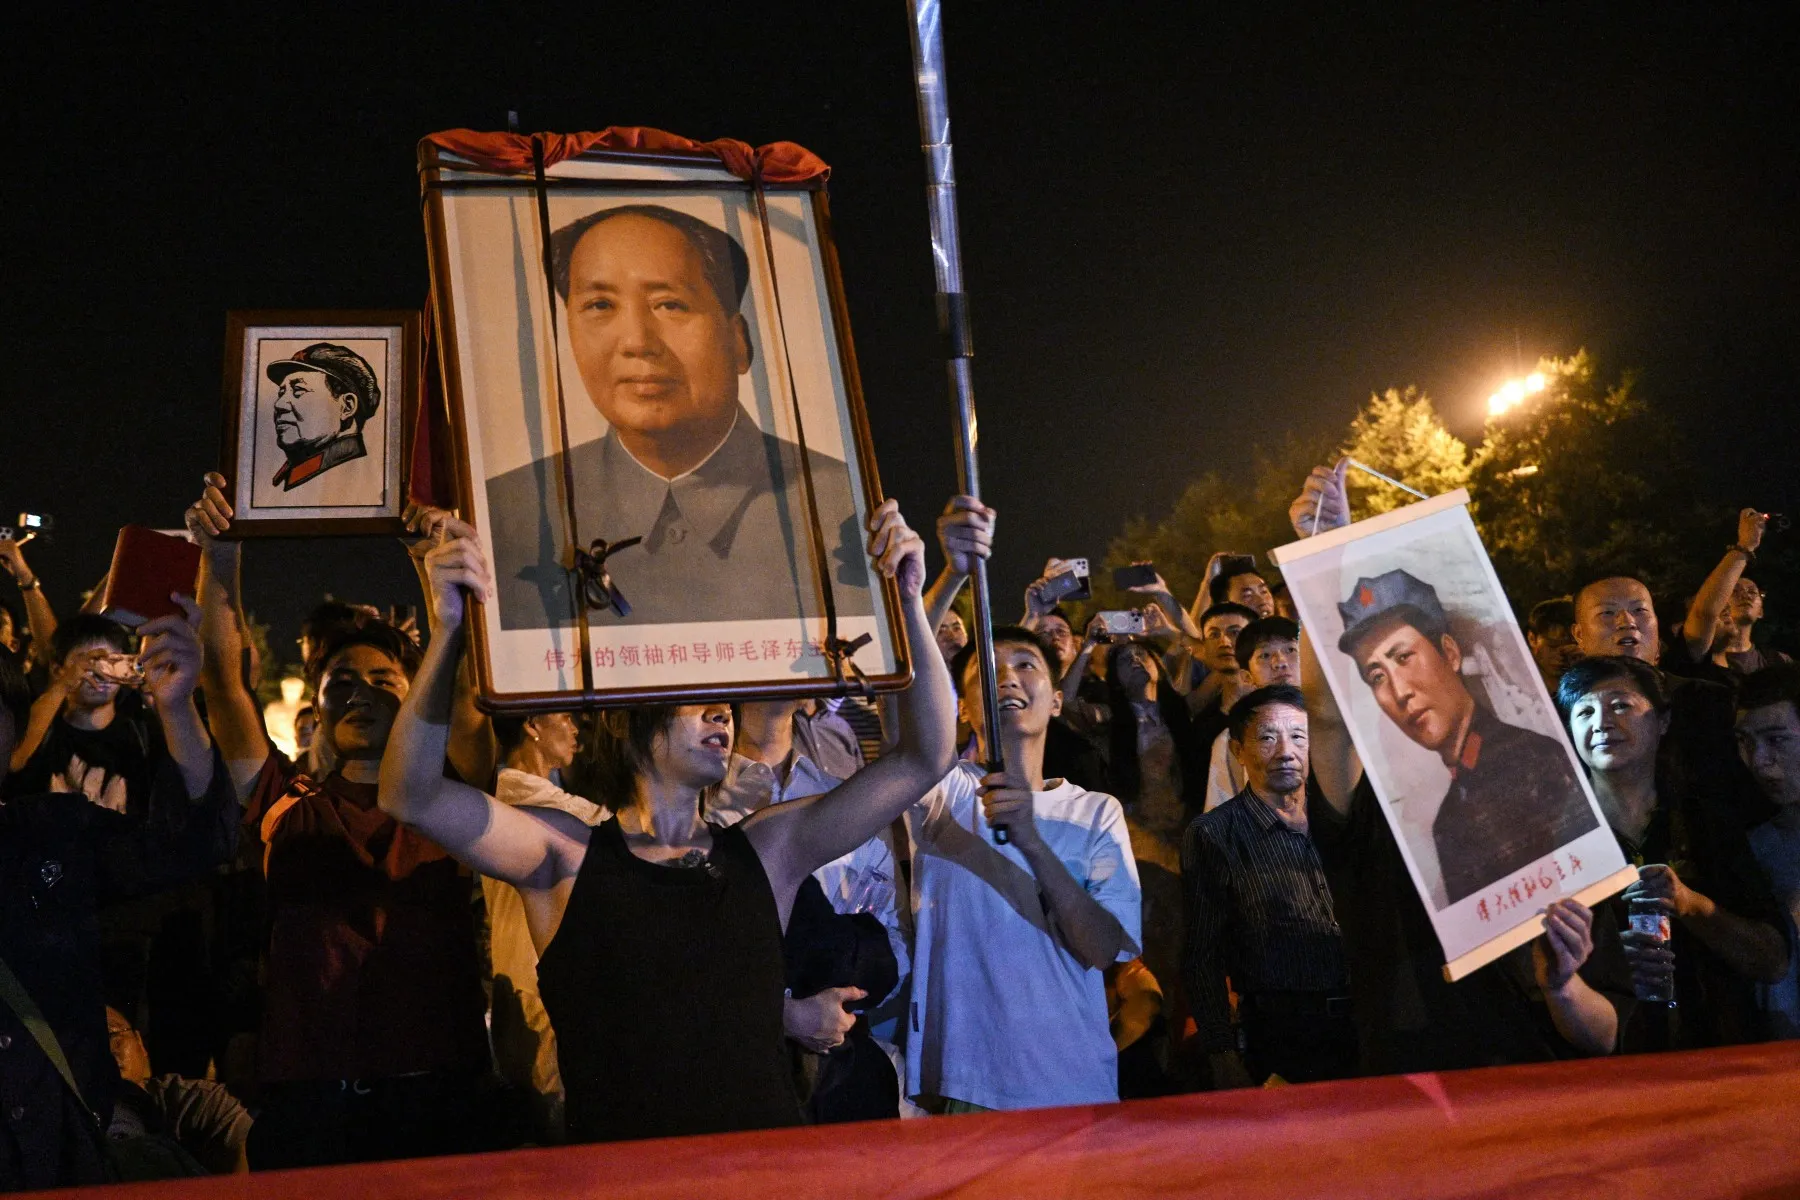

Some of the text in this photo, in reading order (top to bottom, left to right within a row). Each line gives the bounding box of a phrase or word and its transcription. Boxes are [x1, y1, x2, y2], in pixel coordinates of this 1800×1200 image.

[543, 635, 847, 671] 伟大的领袖和导师毛泽东主
